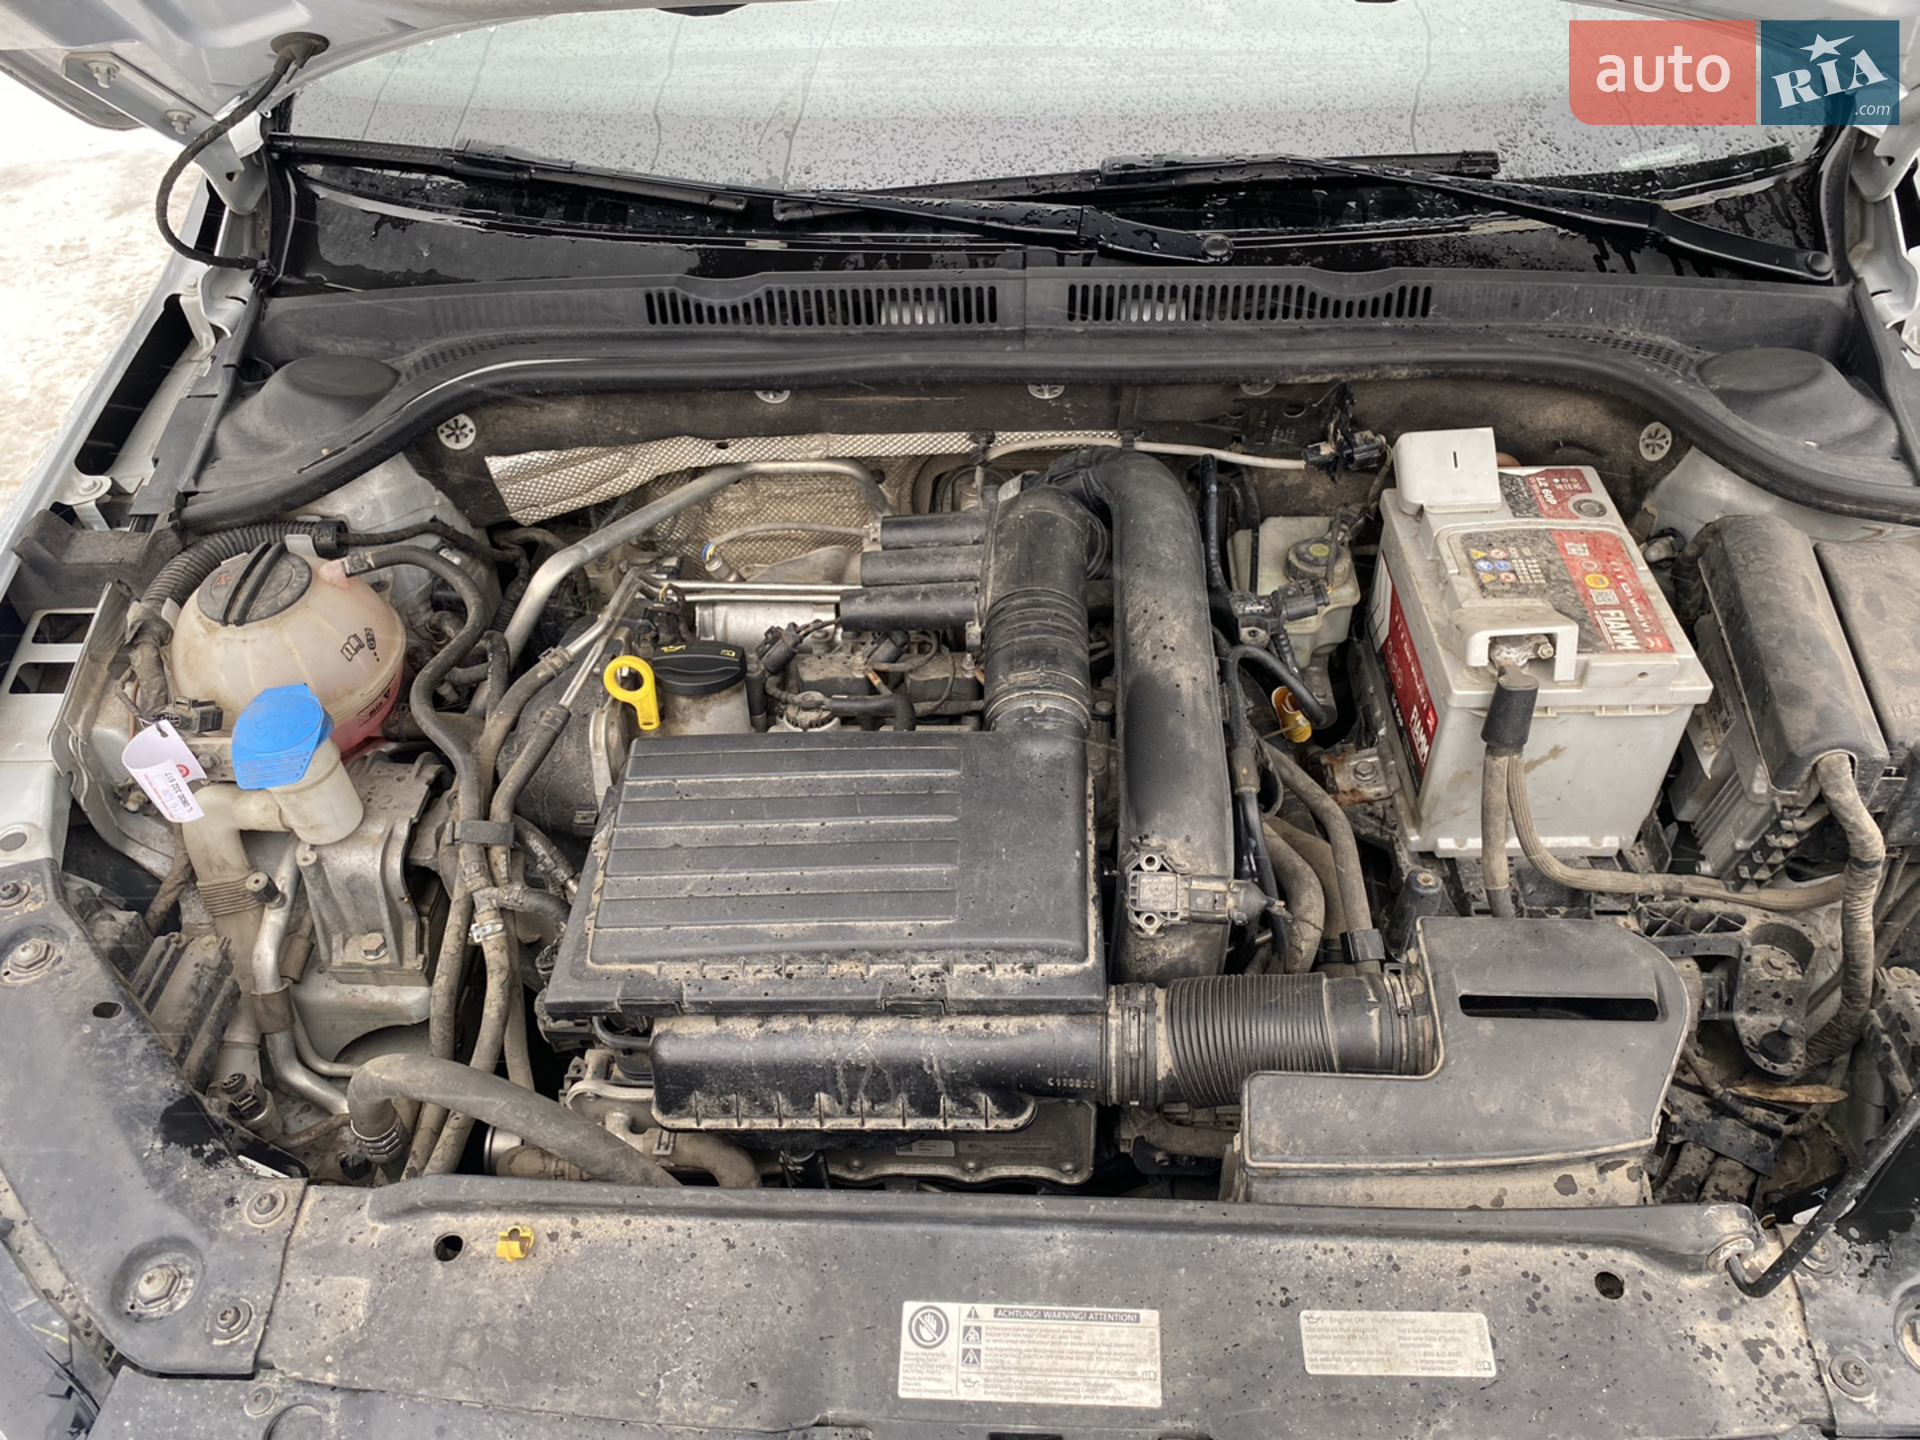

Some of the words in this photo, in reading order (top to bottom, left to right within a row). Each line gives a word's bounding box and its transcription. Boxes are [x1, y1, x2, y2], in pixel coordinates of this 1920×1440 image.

[1600, 609, 1640, 652] FIAMM
[996, 1309, 1042, 1320] ACHTUNG!
[1043, 1311, 1087, 1321] WARNING!
[1088, 1312, 1138, 1322] ATTENTION!
